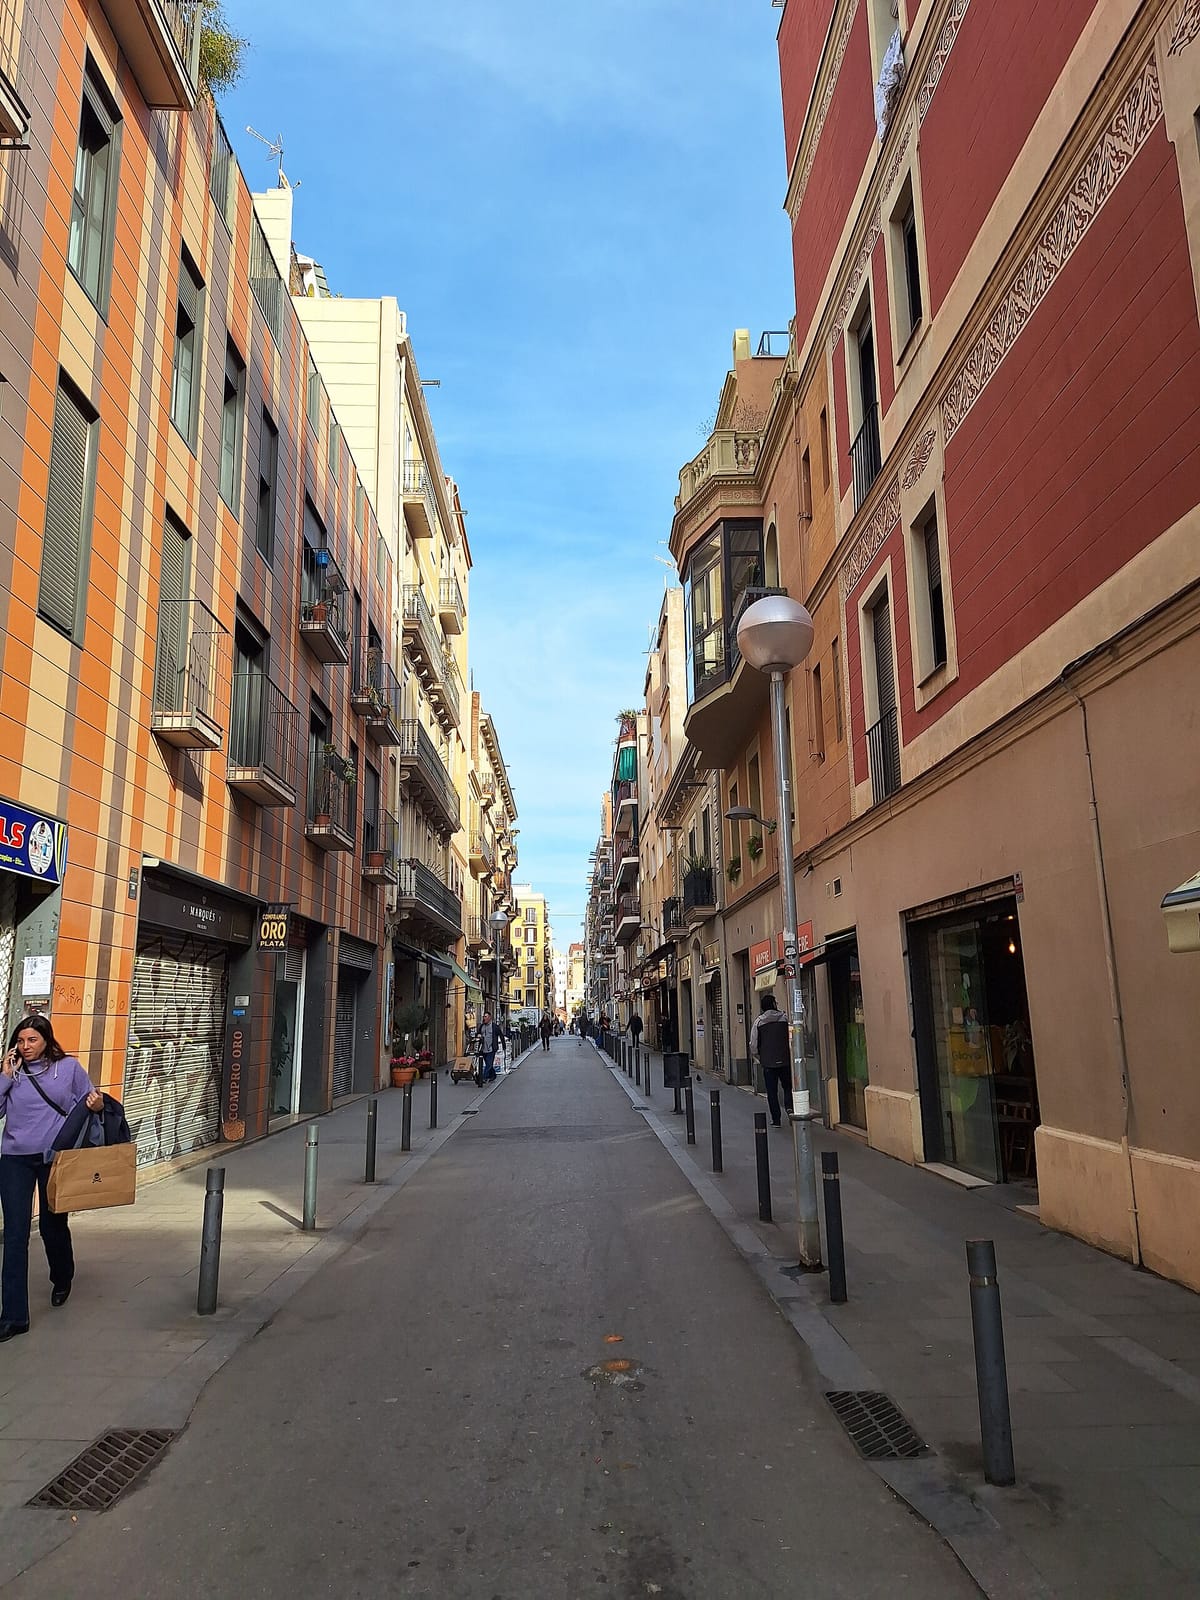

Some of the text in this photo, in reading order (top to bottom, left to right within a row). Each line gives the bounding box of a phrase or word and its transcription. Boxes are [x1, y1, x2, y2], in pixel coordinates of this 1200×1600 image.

[190, 905, 216, 922] MARQUÉS
[261, 921, 287, 940] ORO
[231, 1030, 243, 1059] ORO
[228, 1062, 241, 1121] COMPRO
